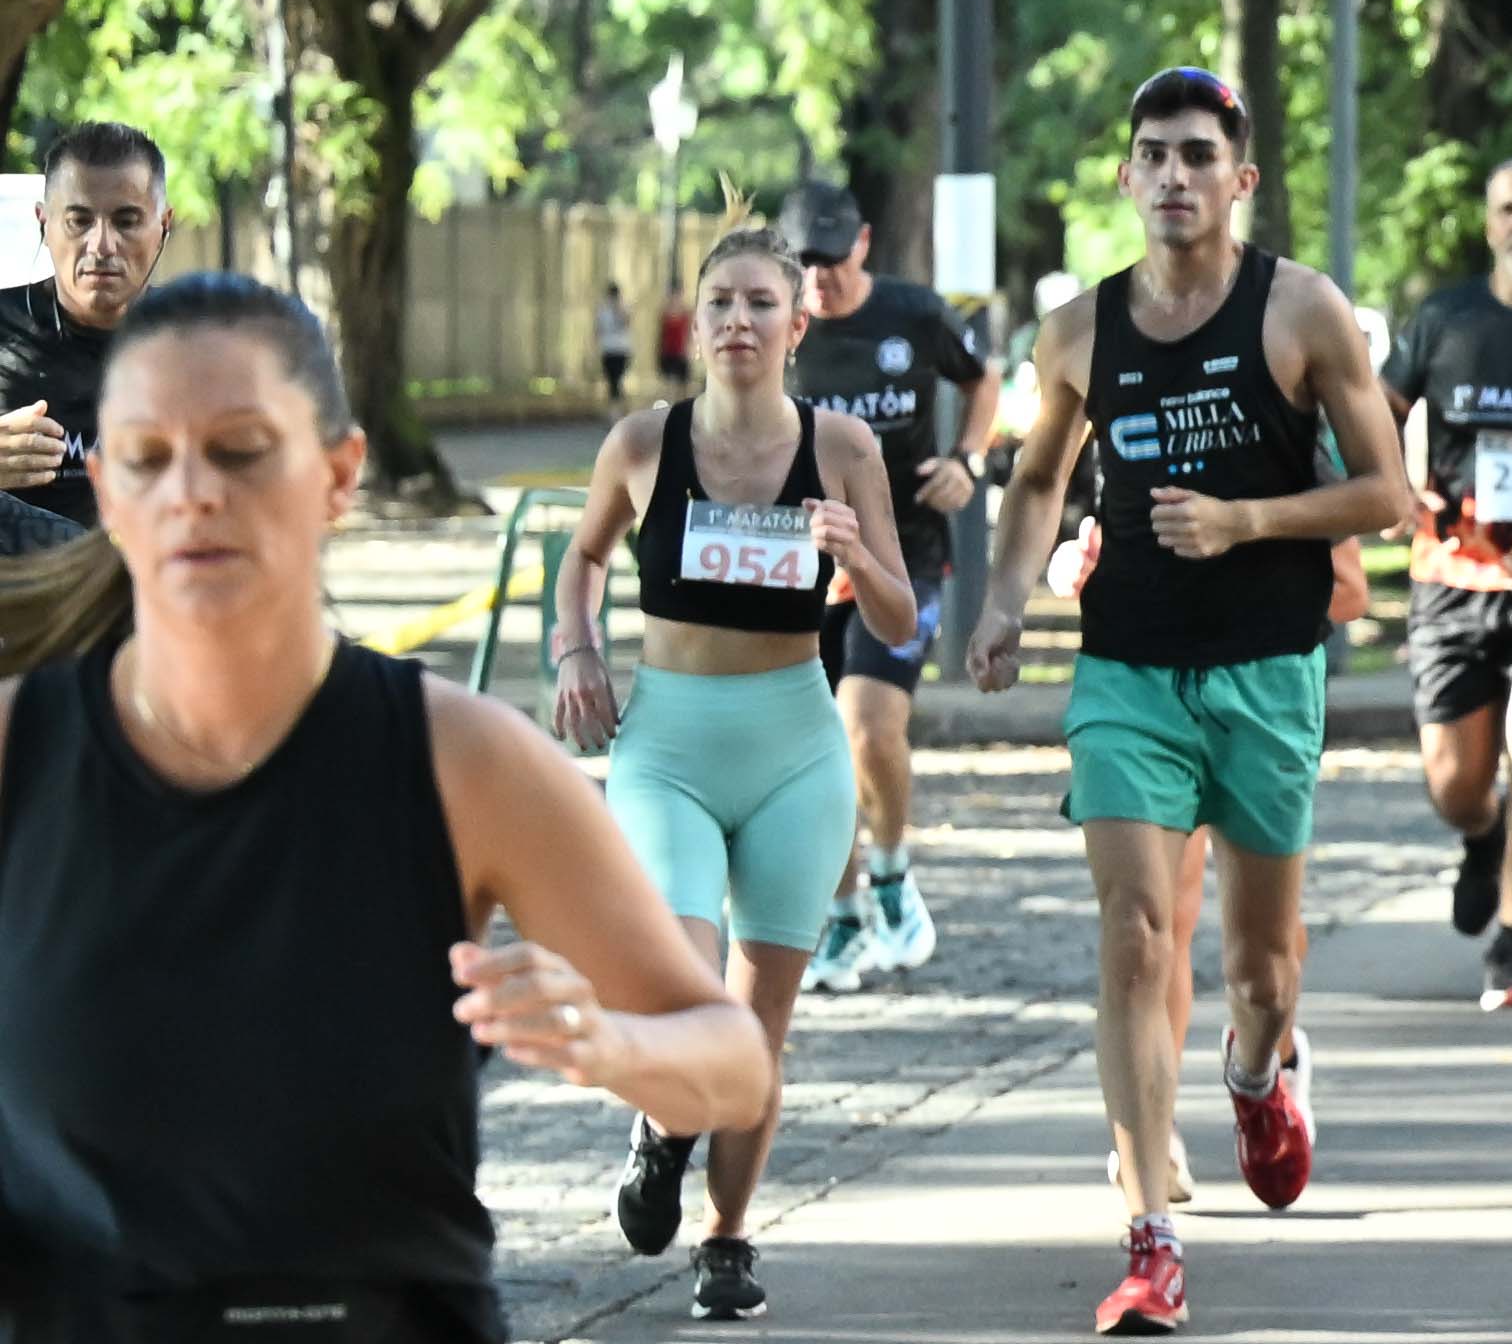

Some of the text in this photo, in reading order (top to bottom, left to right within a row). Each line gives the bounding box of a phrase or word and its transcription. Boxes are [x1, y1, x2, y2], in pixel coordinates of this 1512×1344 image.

[800, 384, 916, 418] ARATÓN
[1165, 401, 1245, 431] MILLA
[1167, 423, 1261, 454] URBANA
[727, 509, 805, 531] MARATÓN
[699, 544, 803, 589] 954
